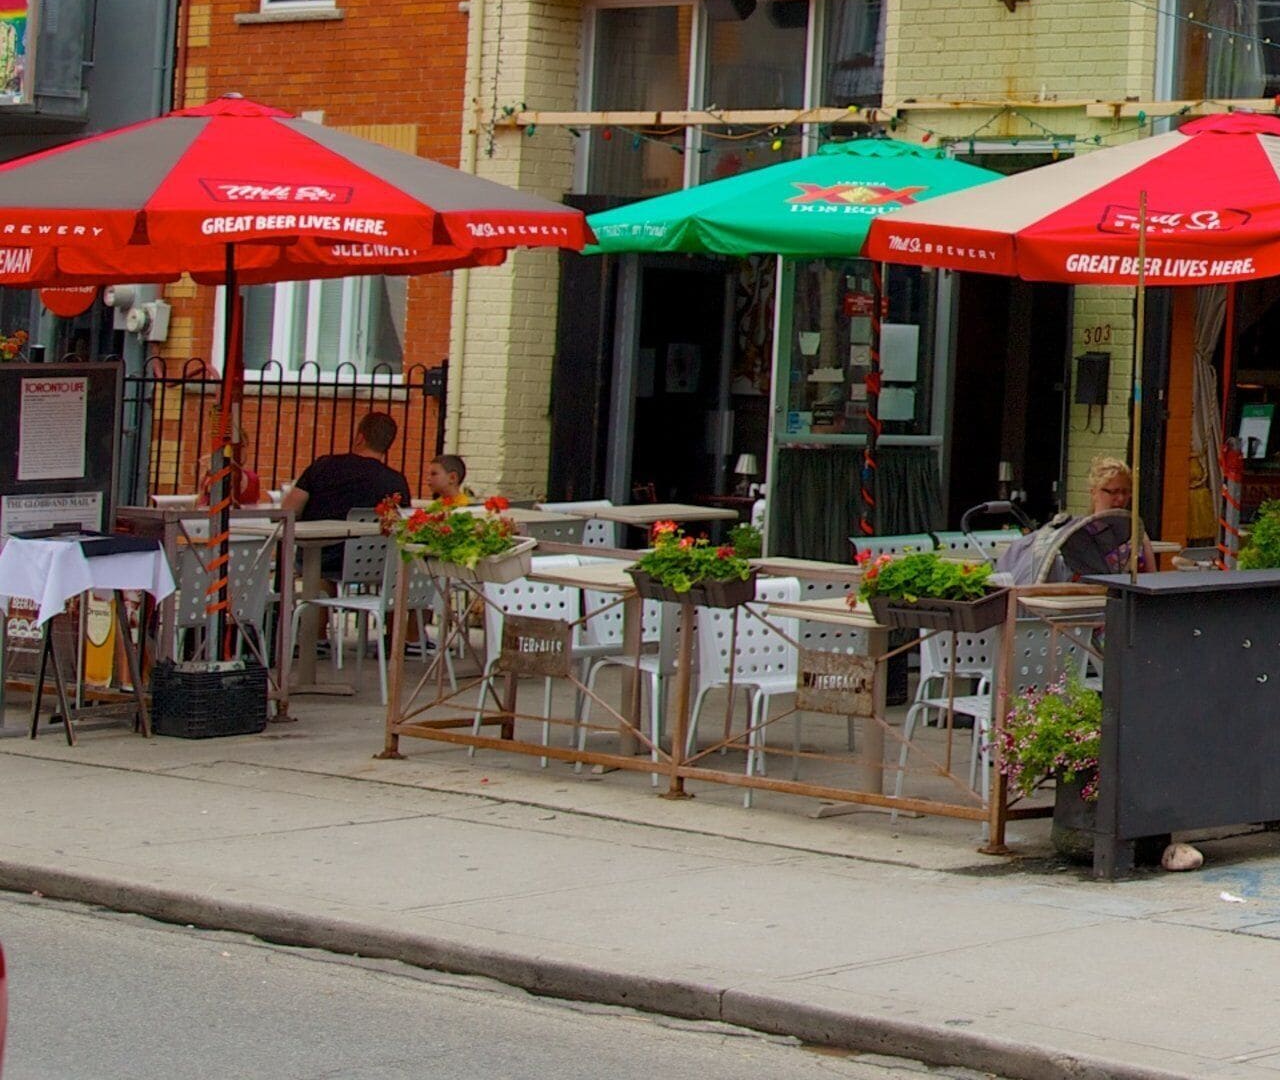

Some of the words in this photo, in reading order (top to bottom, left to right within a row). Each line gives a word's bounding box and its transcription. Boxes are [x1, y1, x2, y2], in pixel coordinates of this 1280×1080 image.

[201, 216, 254, 235] GREAT
[255, 215, 296, 230] BEER
[299, 215, 341, 231] LIVES
[343, 218, 389, 236] HERE.
[888, 235, 910, 252] Mill
[924, 243, 997, 259] BREWERY
[1066, 254, 1121, 273] GREAT
[1119, 256, 1161, 276] BEER
[1163, 258, 1207, 277] LIVES
[1209, 258, 1256, 276] HERE.
[1083, 324, 1111, 345] 303
[25, 382, 70, 394] TORONTO
[71, 381, 85, 393] LIFE
[7, 499, 24, 509] THE
[24, 498, 50, 508] GLOBE
[51, 498, 69, 507] AND
[70, 496, 91, 507] MAIL
